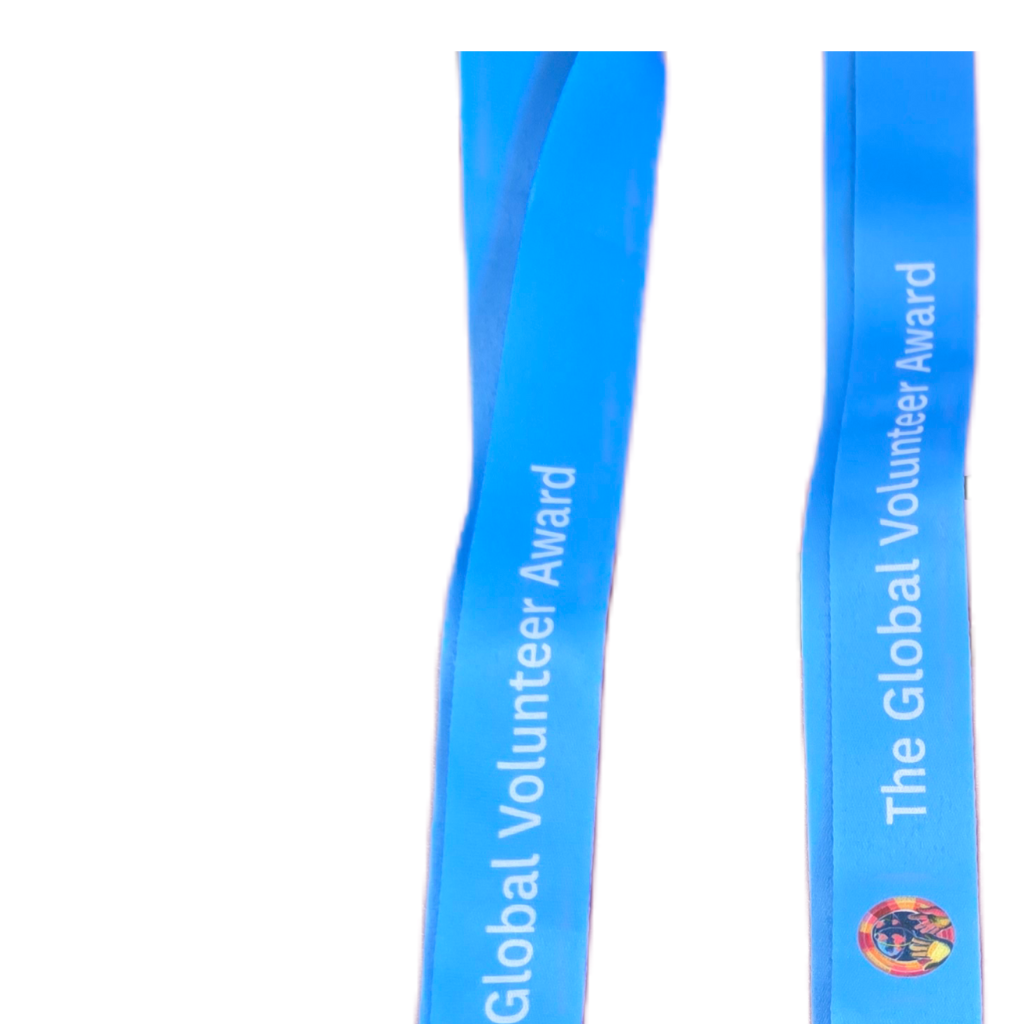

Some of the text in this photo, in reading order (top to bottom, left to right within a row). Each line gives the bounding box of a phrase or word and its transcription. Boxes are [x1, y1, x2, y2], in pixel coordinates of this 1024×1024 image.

[519, 463, 576, 587] Award
[875, 262, 935, 825] The Global Volunteer Award
[496, 598, 556, 840] Volunteer
[482, 853, 540, 1024] Global
